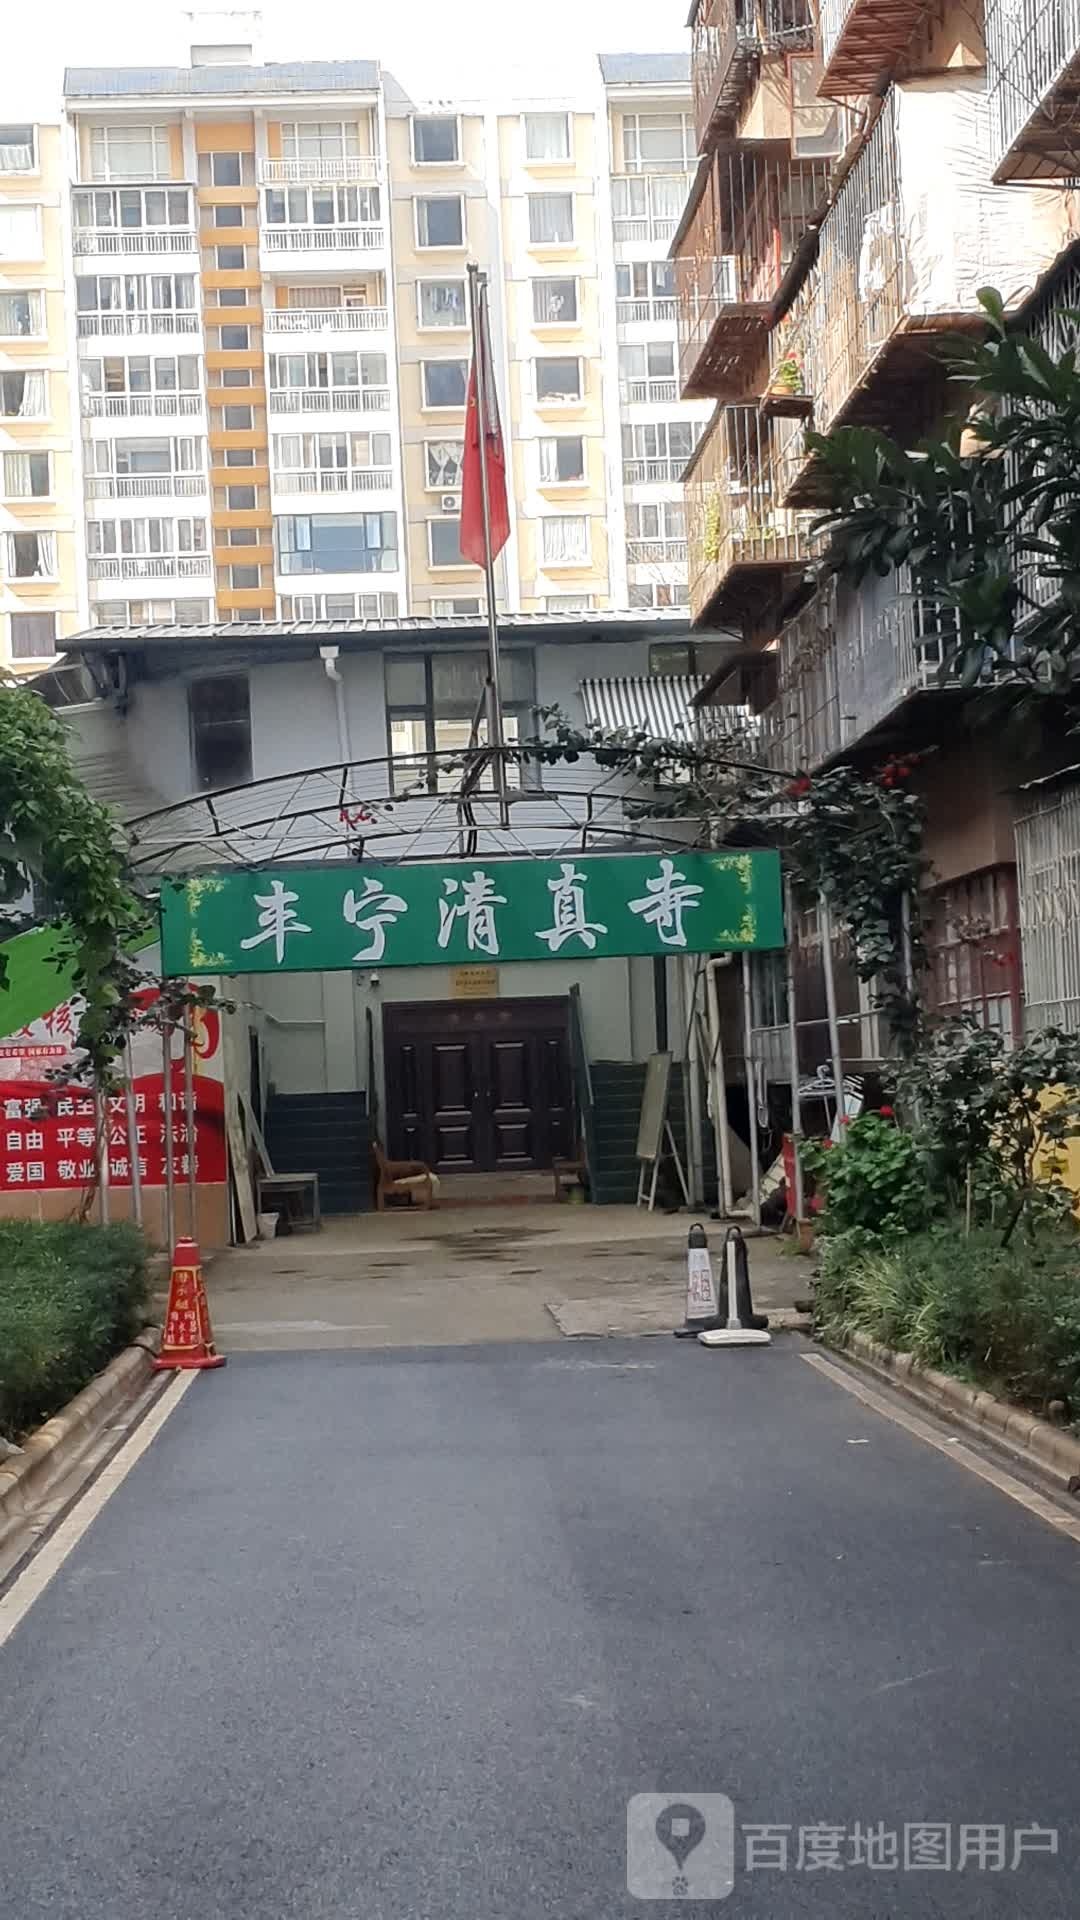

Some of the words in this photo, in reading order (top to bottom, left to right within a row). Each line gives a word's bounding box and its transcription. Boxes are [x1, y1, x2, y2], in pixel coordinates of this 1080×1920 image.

[240, 860, 703, 964] 丰宁清真寺
[4, 1098, 42, 1119] 富强
[57, 1097, 95, 1116] 民主
[6, 1129, 43, 1151] 自由
[57, 1127, 95, 1149] 平等
[6, 1161, 45, 1183] 爱国
[57, 1159, 95, 1180] 敬业
